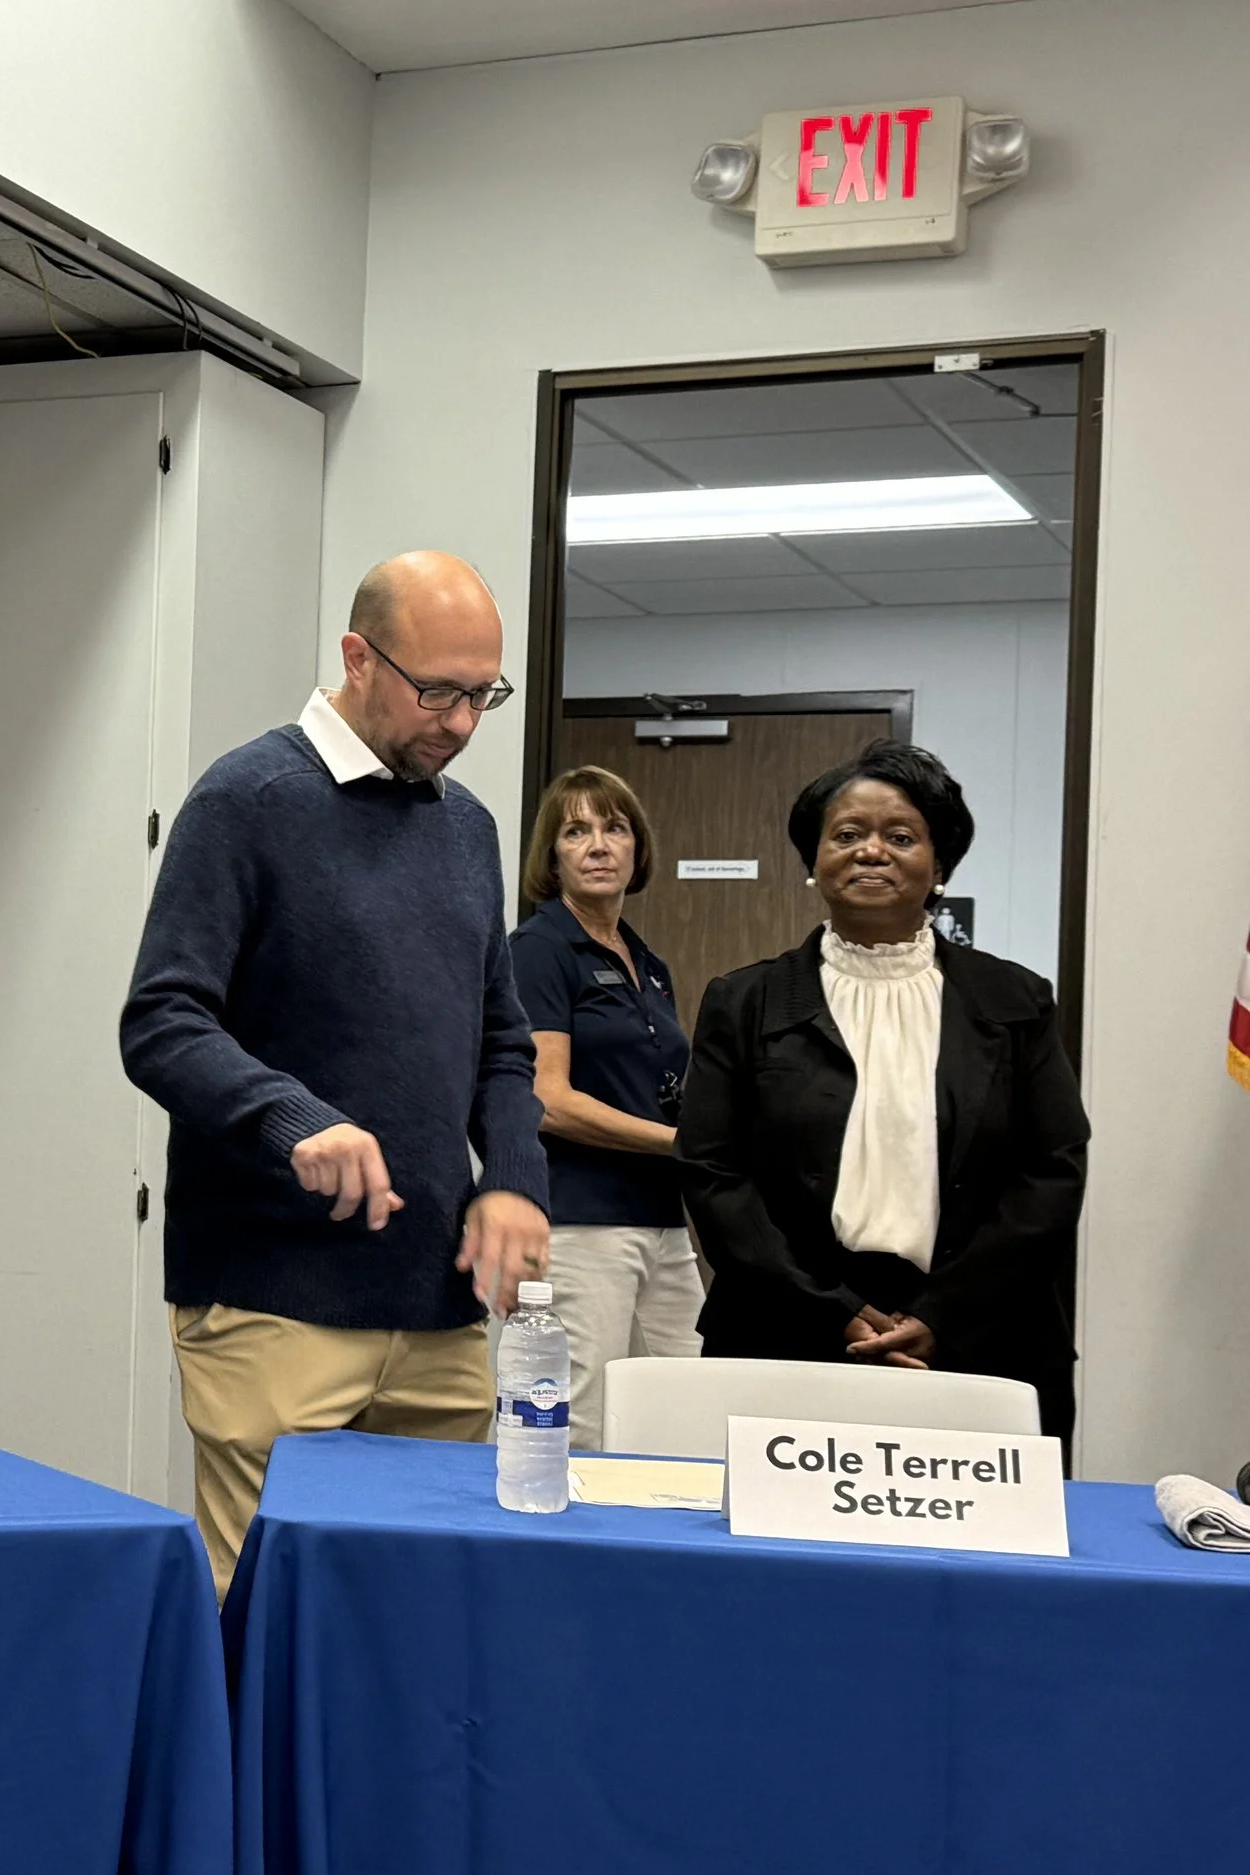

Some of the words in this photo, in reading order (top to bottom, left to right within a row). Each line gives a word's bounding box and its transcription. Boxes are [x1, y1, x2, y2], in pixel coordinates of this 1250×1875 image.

[796, 107, 933, 208] EXIT
[765, 1435, 864, 1475] Cole
[875, 1442, 1022, 1485] Terrell
[832, 1480, 975, 1522] Setzer
